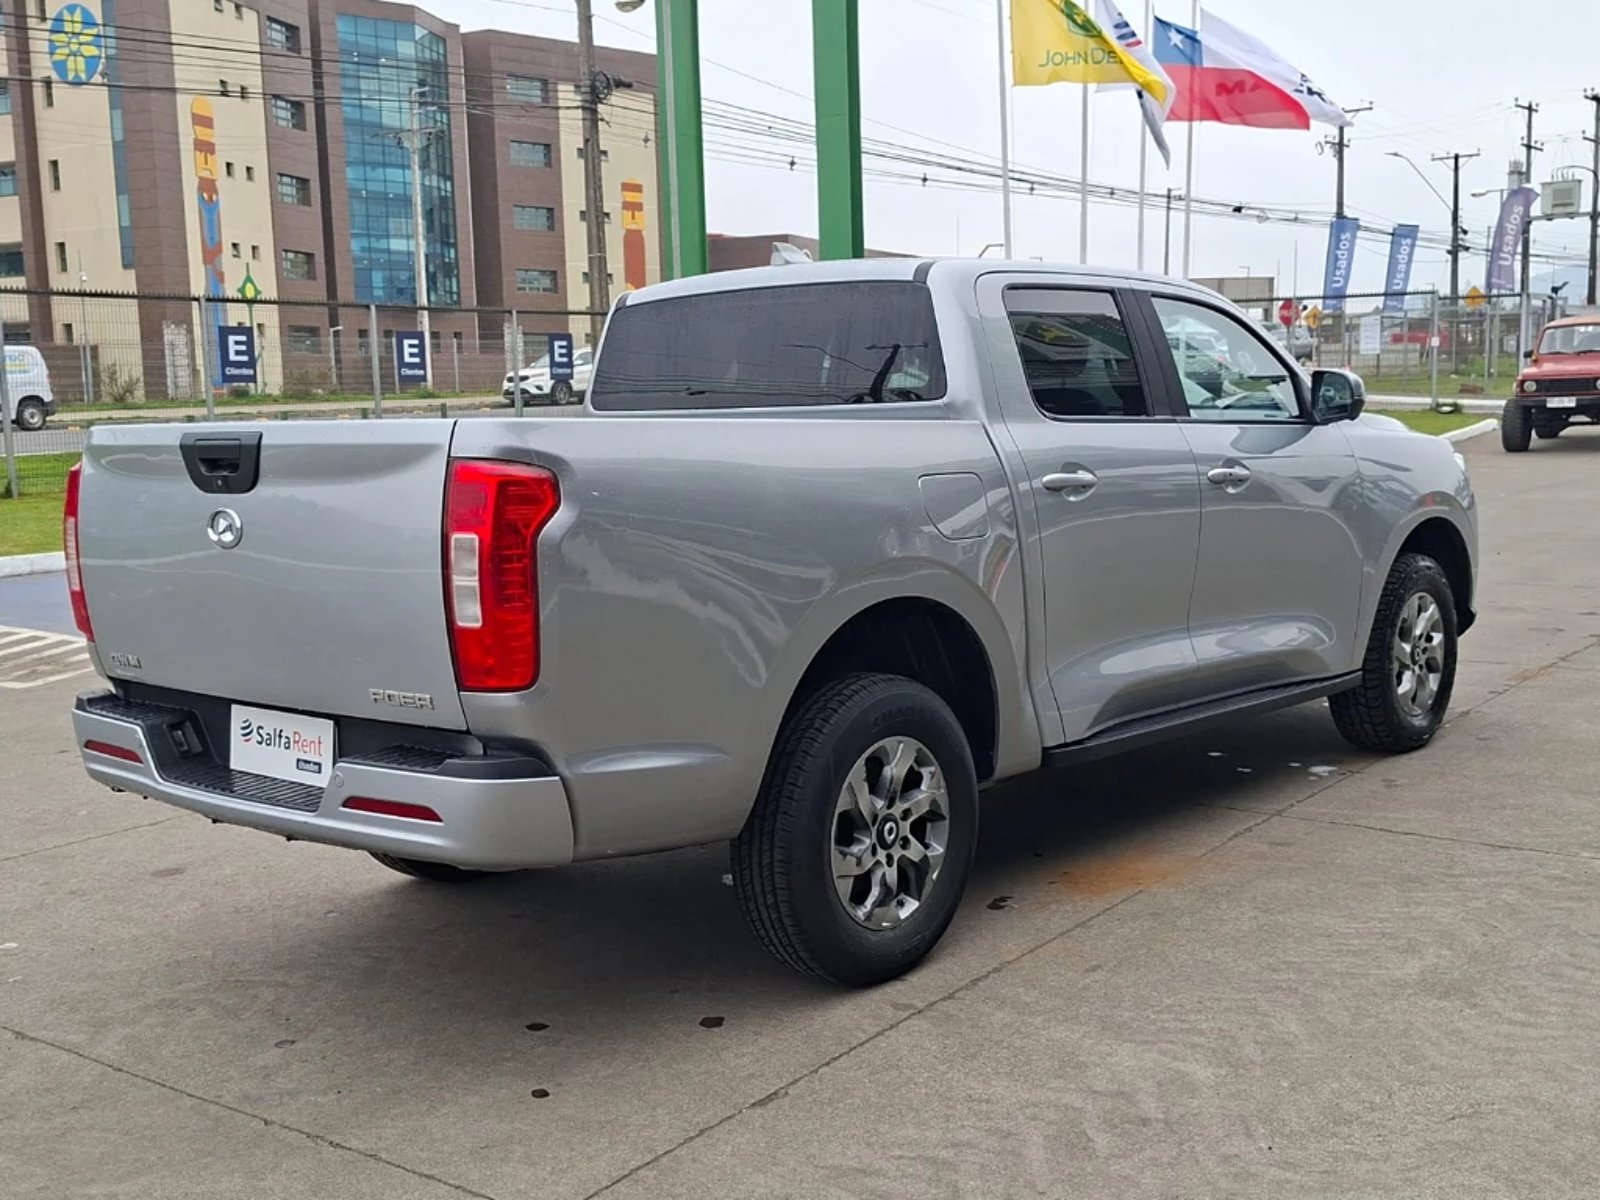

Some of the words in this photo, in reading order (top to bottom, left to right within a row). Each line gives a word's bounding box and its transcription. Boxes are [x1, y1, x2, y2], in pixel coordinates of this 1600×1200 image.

[1038, 49, 1088, 67] JOHN
[1090, 47, 1124, 65] DE
[1497, 204, 1524, 266] Usados
[1331, 232, 1351, 288] Usados
[1392, 238, 1412, 290] Usados
[228, 335, 249, 361] E
[403, 339, 421, 363] E
[553, 340, 568, 362] E
[255, 725, 323, 757] SalfaRent
